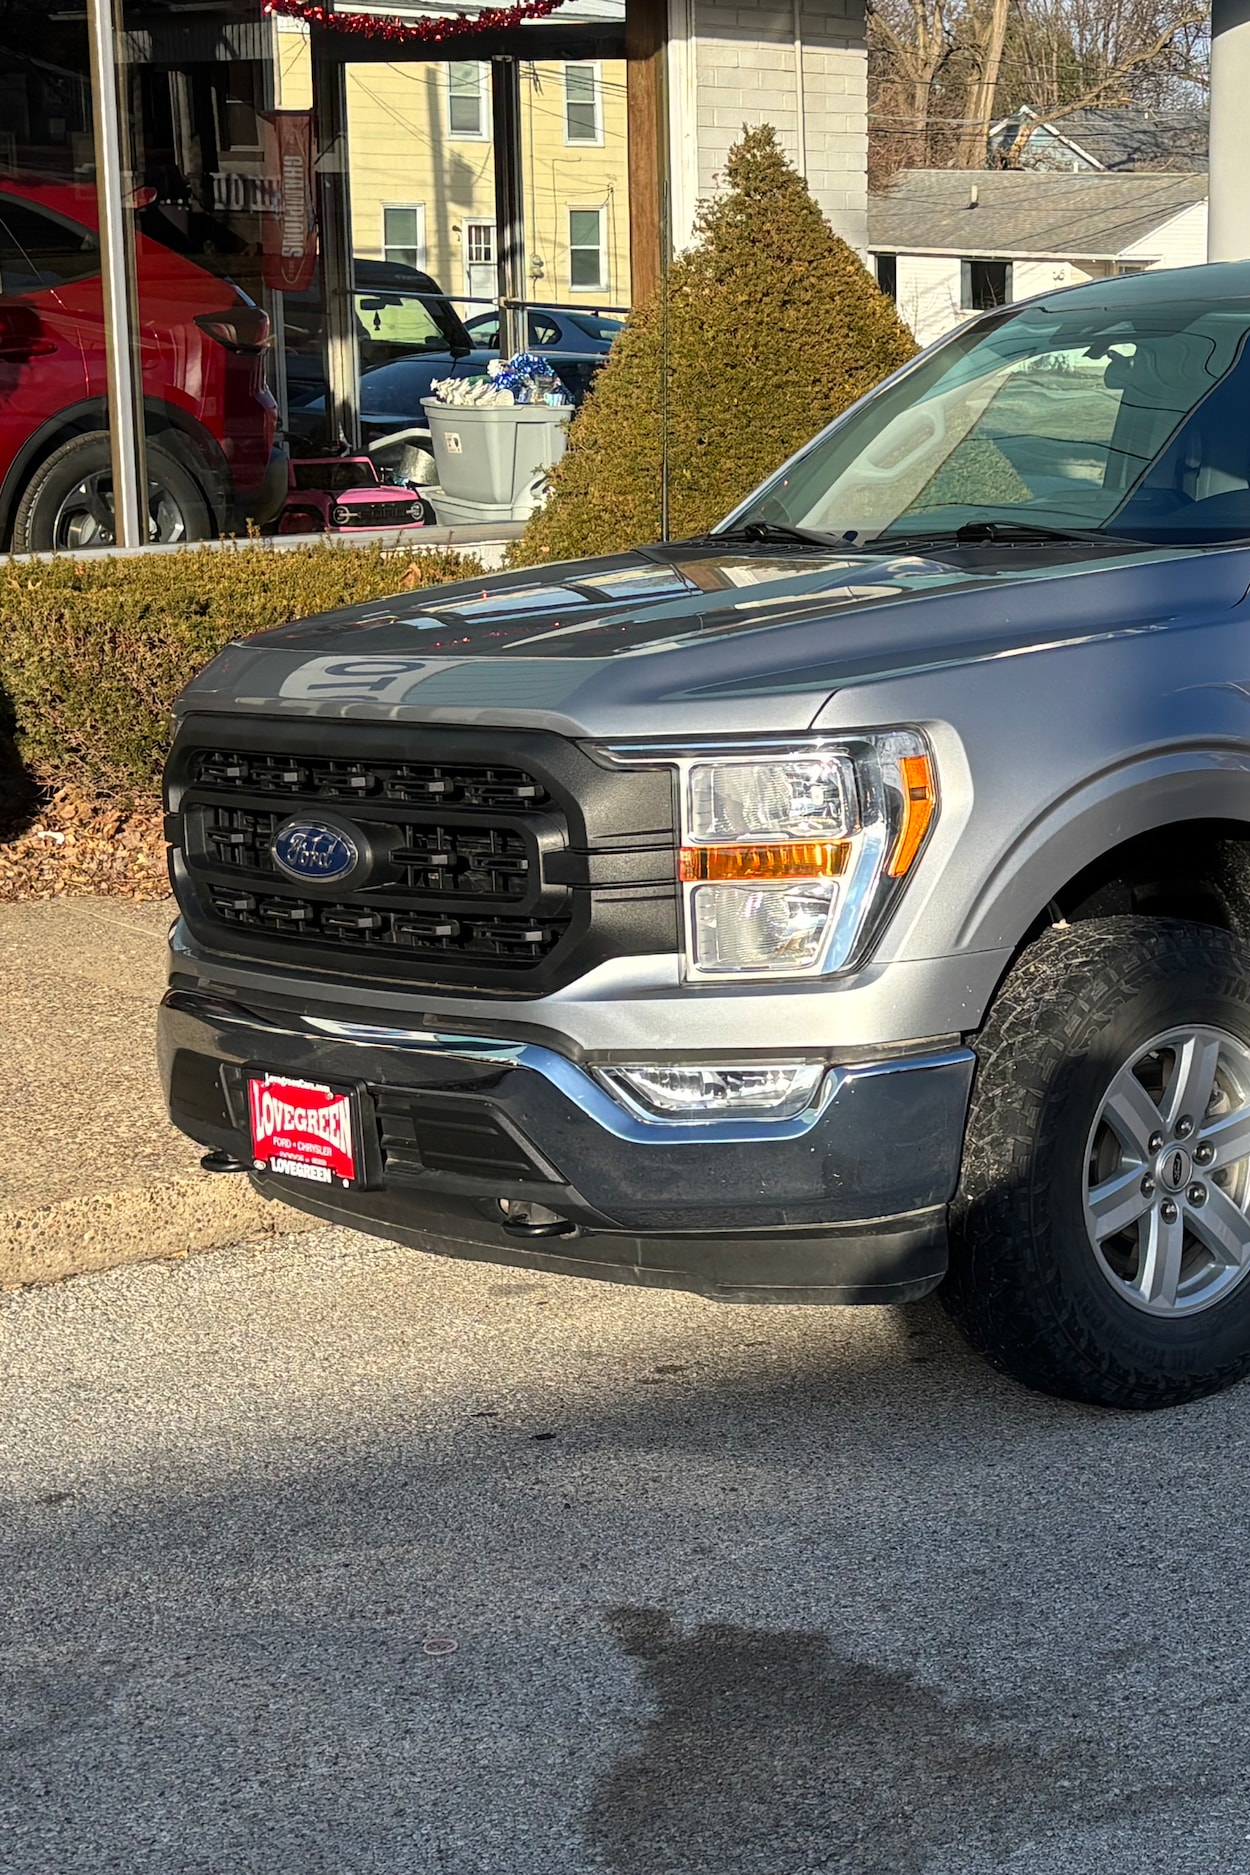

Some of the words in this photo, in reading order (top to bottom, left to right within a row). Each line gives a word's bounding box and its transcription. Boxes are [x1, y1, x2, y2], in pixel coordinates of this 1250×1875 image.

[282, 155, 305, 257] CHAMPIONS
[286, 832, 339, 869] Ford
[252, 1079, 353, 1160] LOVEGREEN
[272, 1136, 292, 1149] FORD
[296, 1141, 333, 1157] CHRYSLER
[270, 1156, 332, 1184] LOVEGREEN
